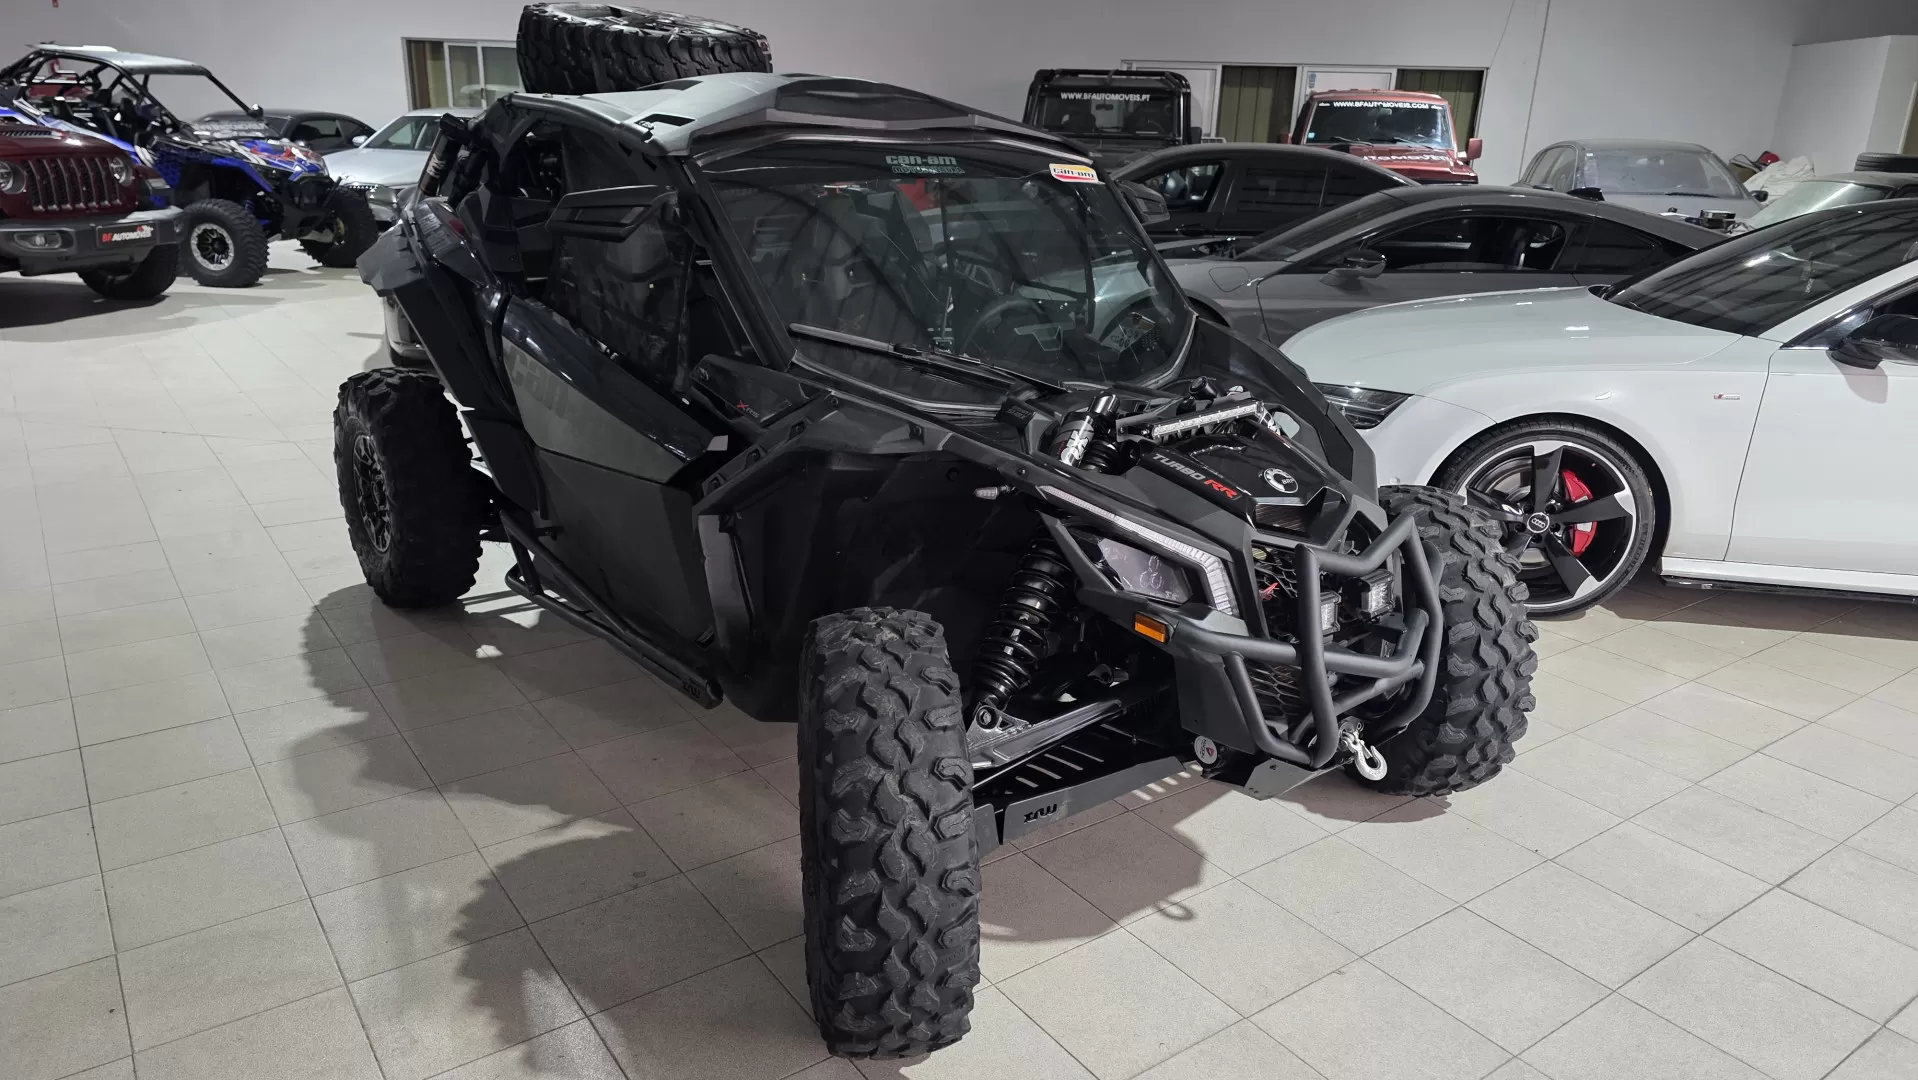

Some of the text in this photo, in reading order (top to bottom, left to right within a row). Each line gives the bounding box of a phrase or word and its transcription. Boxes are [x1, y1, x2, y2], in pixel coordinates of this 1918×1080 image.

[885, 155, 957, 165] can-am
[1152, 453, 1238, 499] TURBO RR
